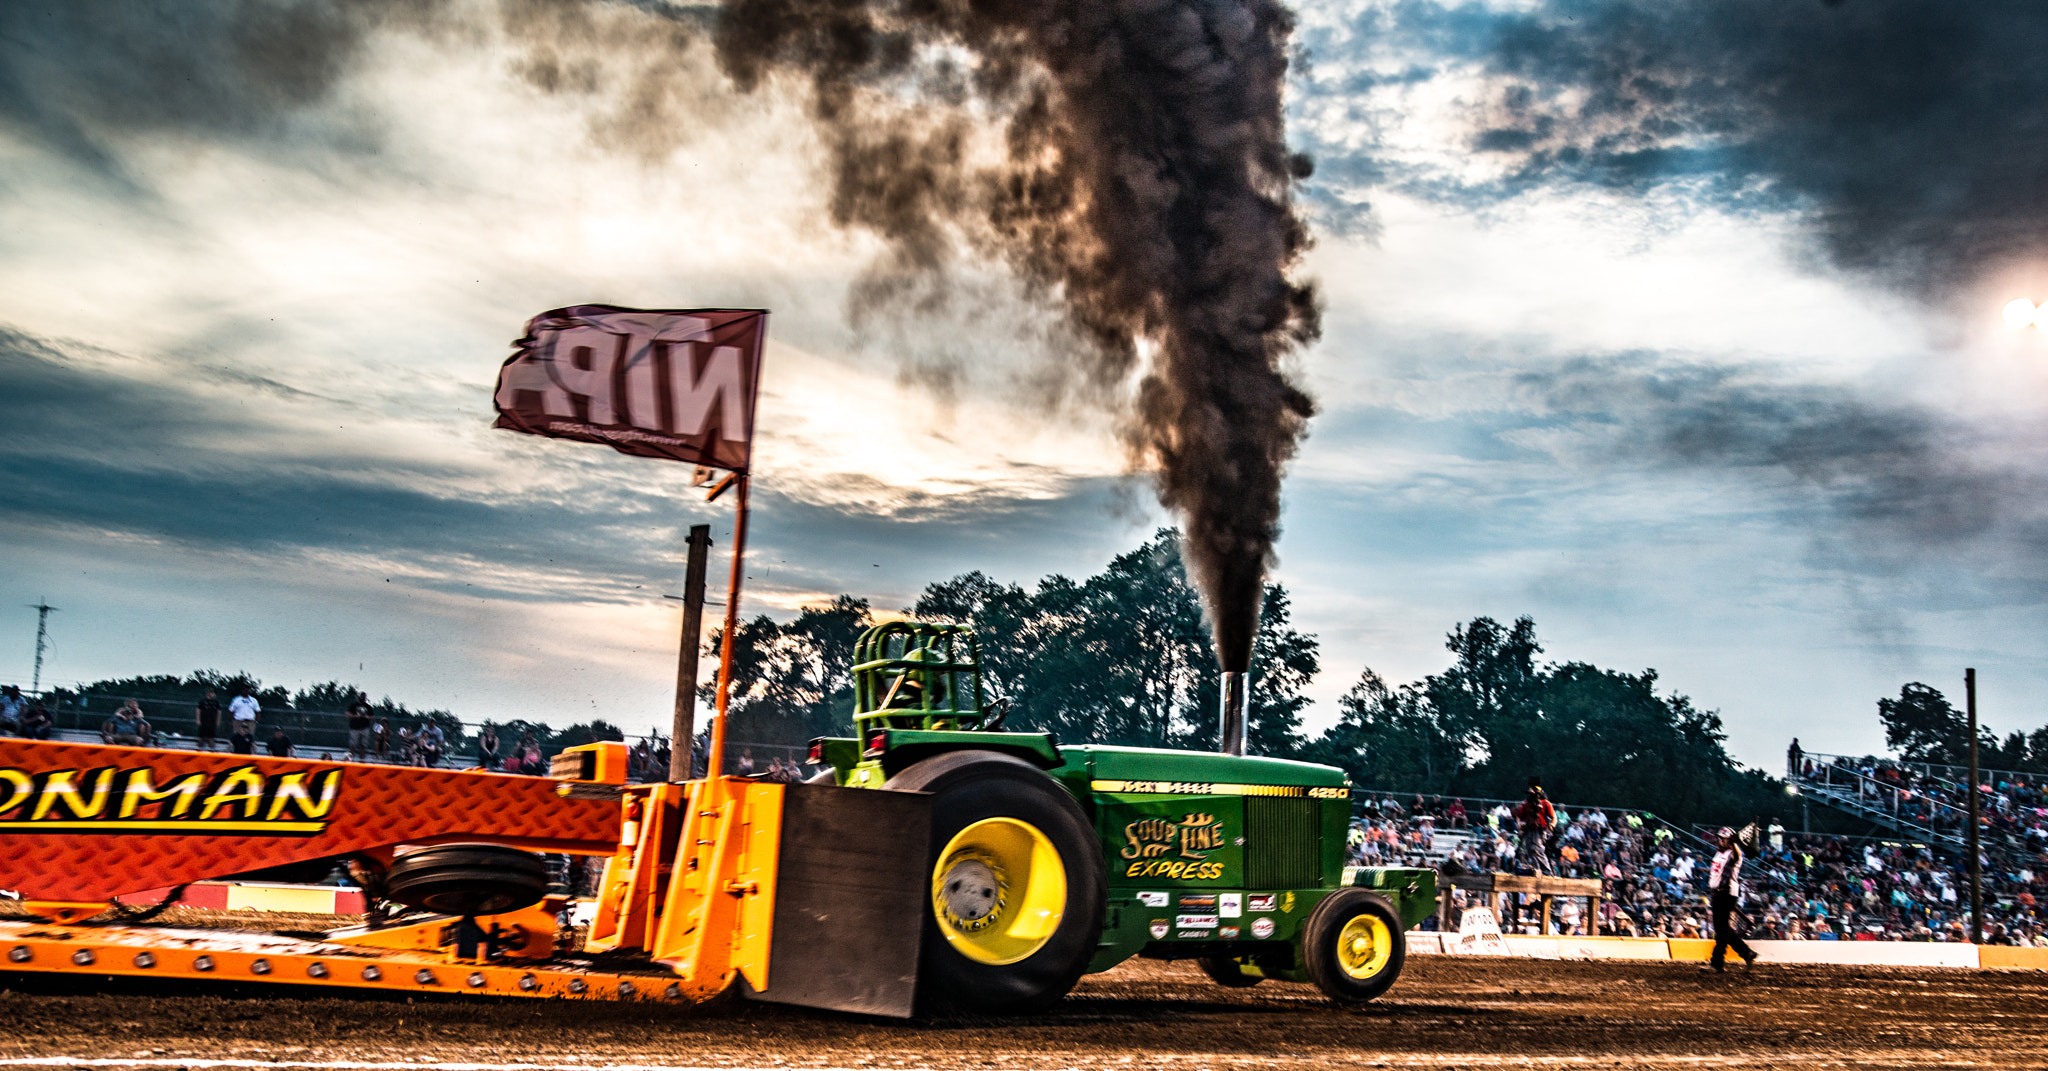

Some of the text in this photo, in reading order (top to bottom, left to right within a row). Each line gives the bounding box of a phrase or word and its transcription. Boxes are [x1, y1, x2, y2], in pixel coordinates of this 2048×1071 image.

[1119, 780, 1213, 795] JOHN DEERE
[1308, 787, 1350, 799] 4250
[1120, 817, 1225, 860] SOUP LINE
[1126, 861, 1225, 880] EXPRESS
